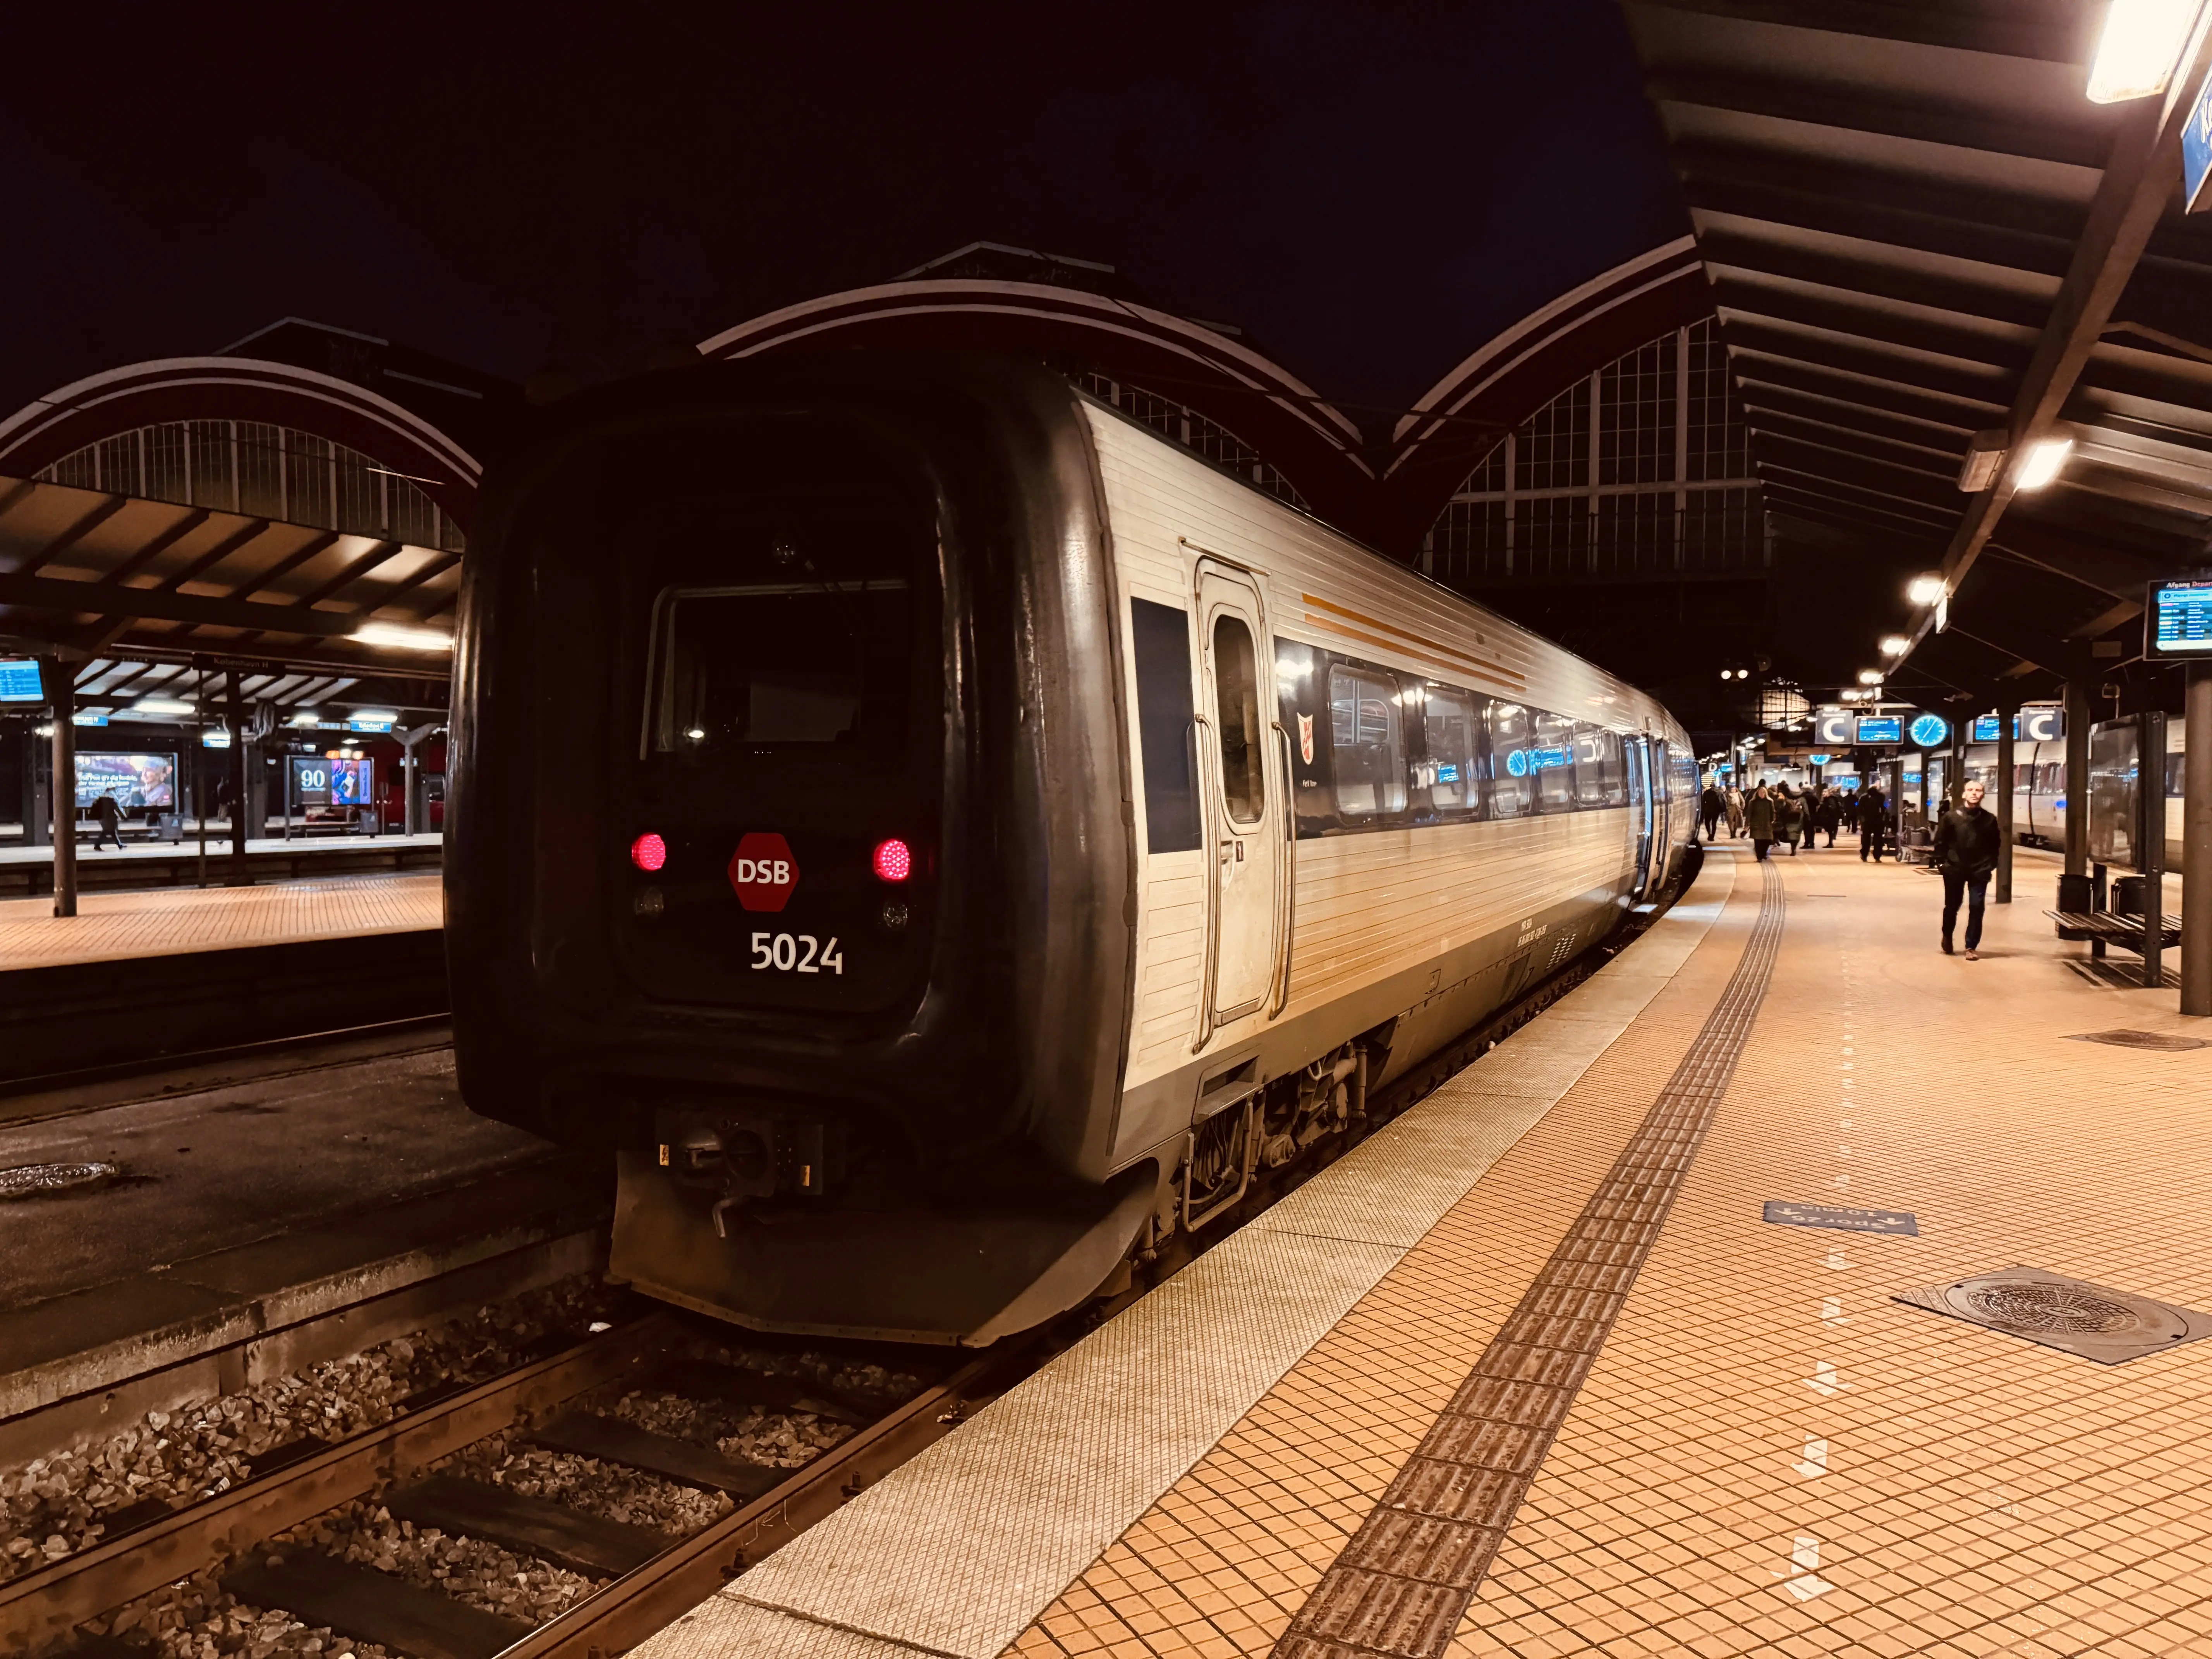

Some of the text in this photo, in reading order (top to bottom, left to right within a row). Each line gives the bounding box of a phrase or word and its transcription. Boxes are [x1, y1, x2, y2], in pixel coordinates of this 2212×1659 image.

[1823, 718, 1844, 742] C
[2029, 715, 2053, 740] C
[1708, 762, 1718, 772] D
[301, 769, 326, 787] 90
[738, 859, 790, 884] DSB
[751, 932, 842, 975] 5024
[1801, 1205, 1878, 1217] 10 min
[1824, 1218, 1886, 1229] Spor
